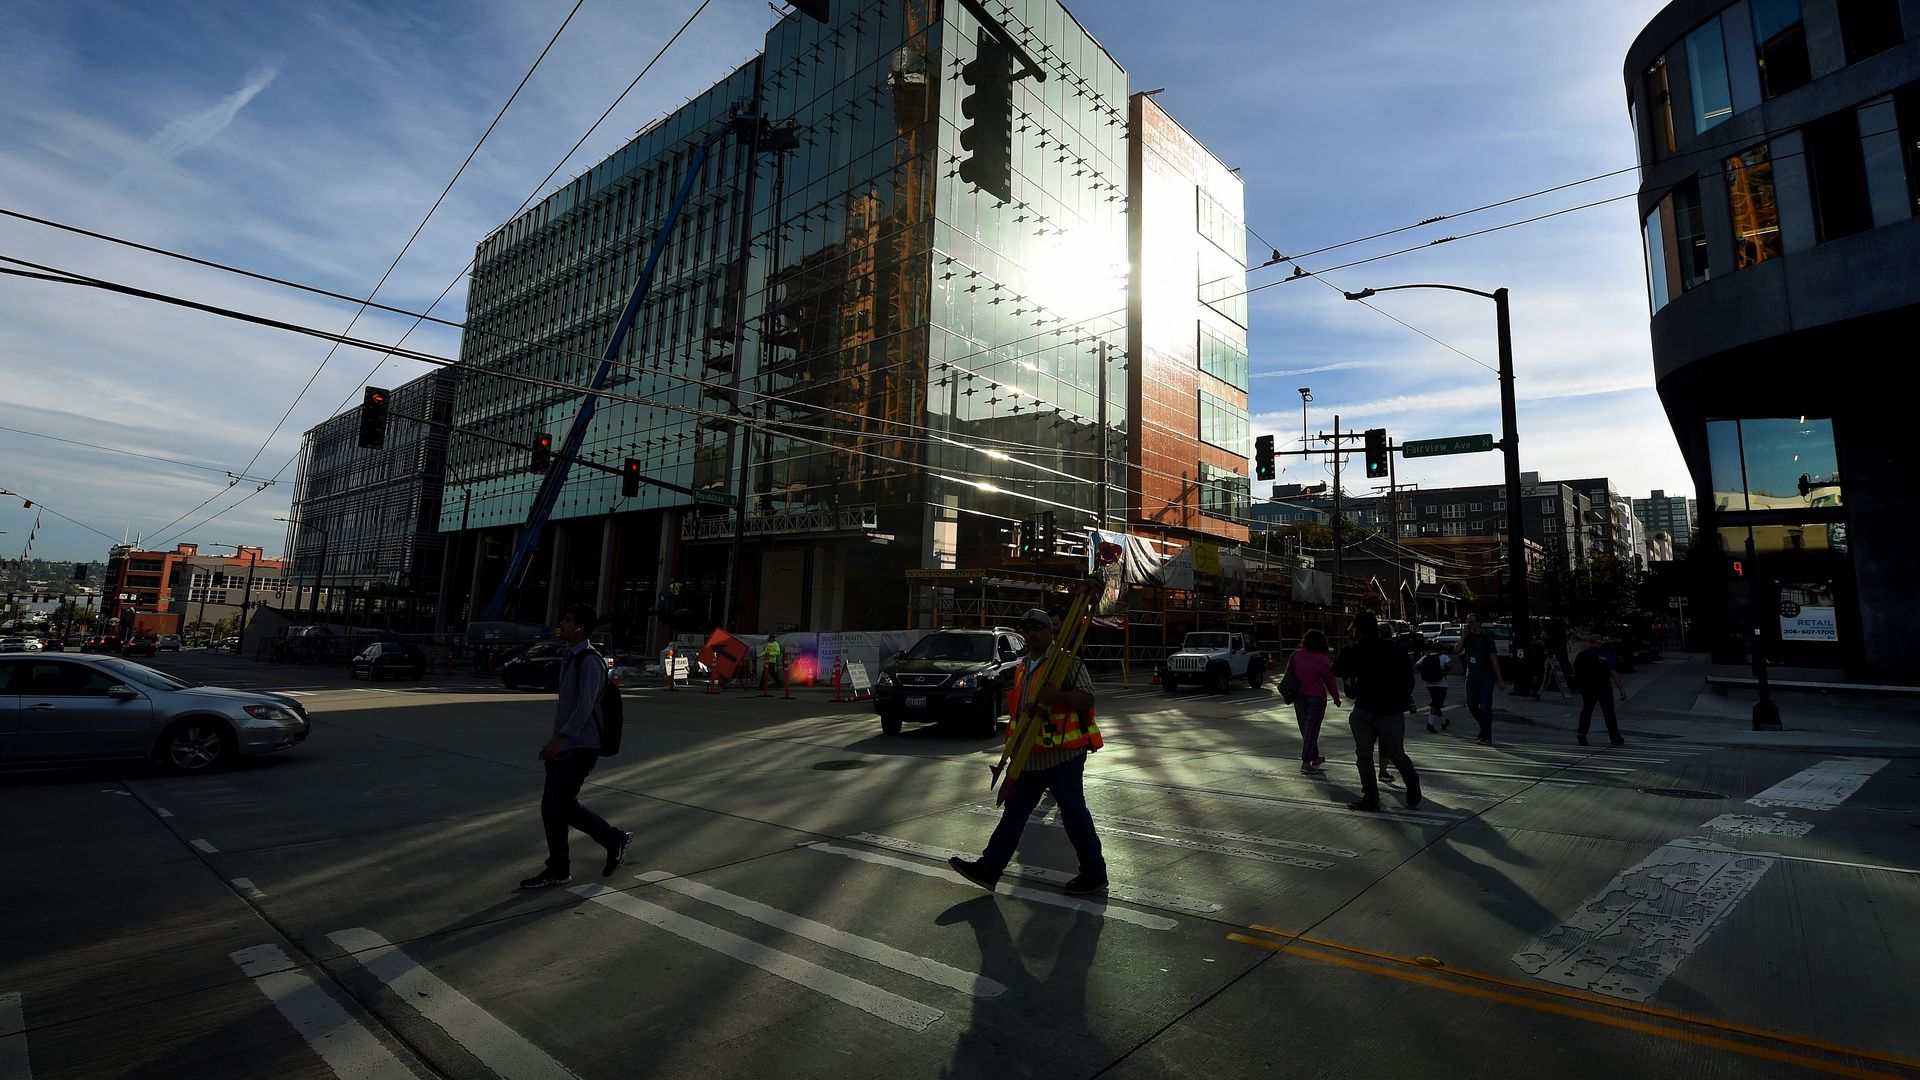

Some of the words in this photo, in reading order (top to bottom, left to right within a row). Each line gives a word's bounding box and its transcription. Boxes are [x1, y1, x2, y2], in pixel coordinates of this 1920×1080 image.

[1406, 443, 1447, 455] Fairview
[1454, 442, 1471, 450] Ave
[1482, 439, 1490, 448] N
[1733, 560, 1743, 576] 9
